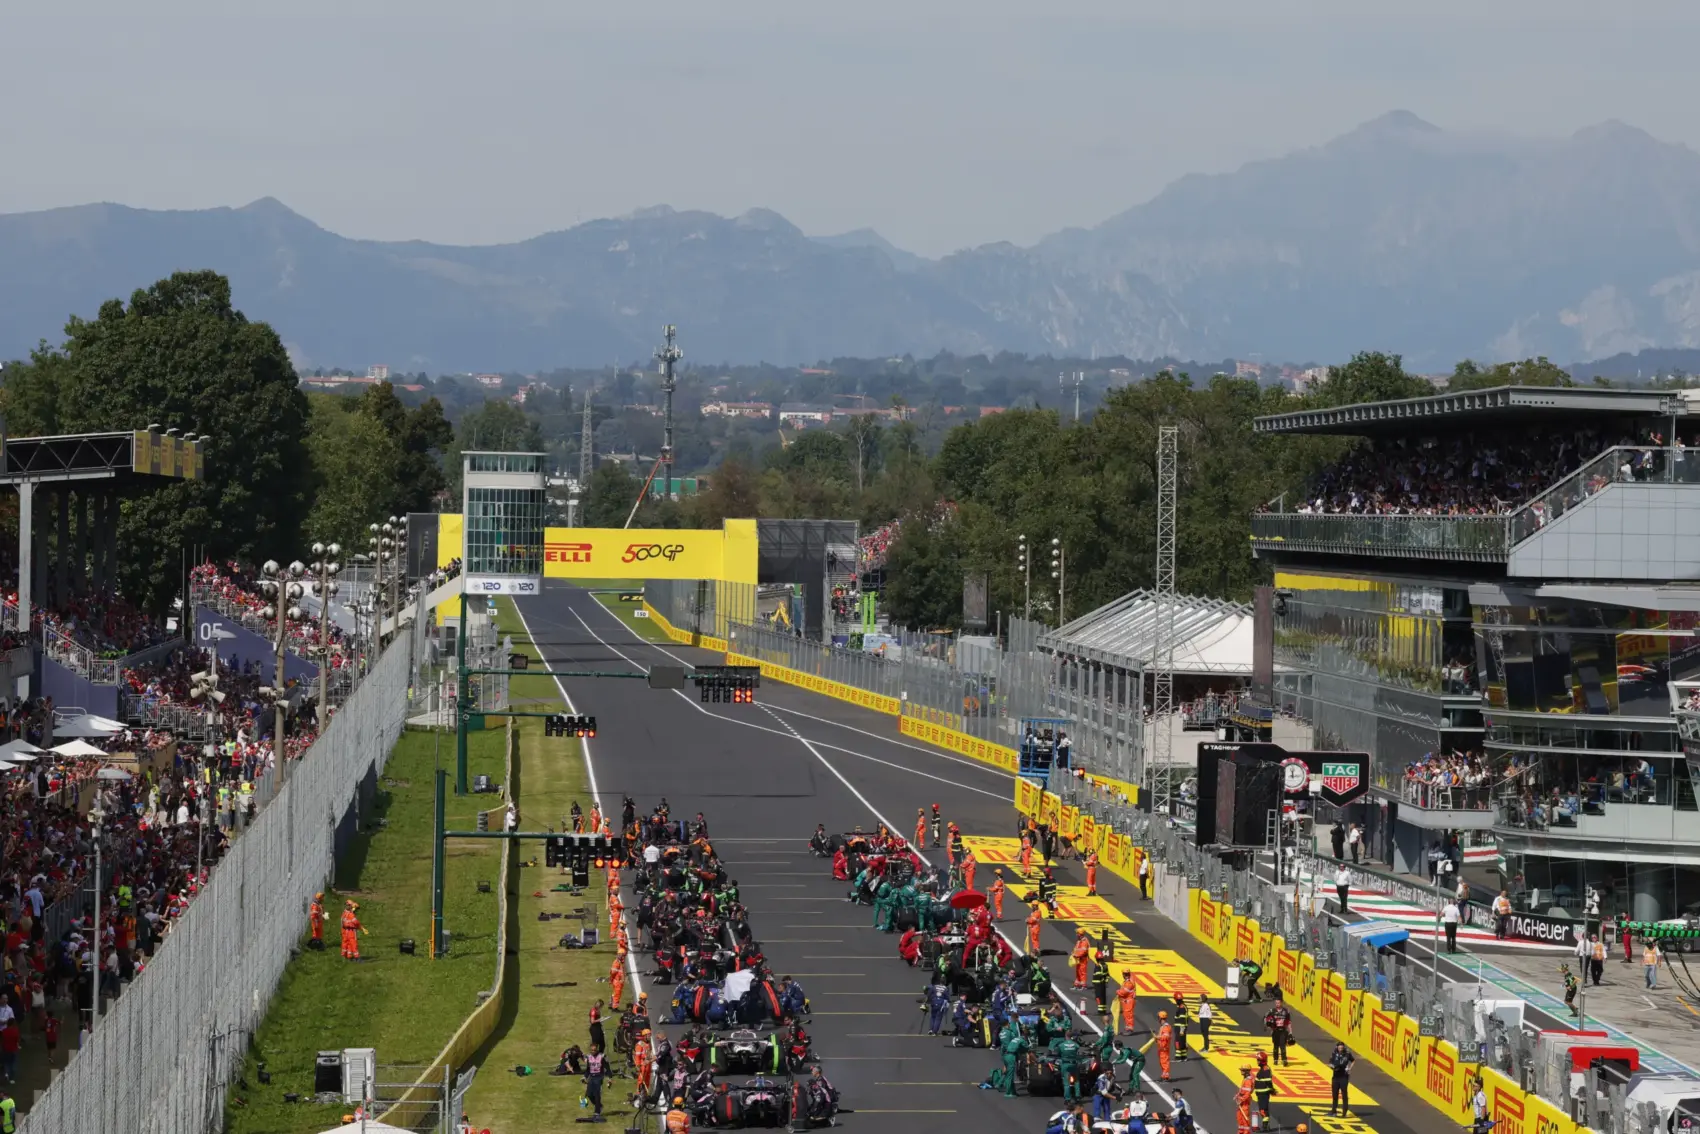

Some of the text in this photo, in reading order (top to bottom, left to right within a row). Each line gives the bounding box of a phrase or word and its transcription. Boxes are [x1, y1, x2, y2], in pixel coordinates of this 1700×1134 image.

[482, 582, 501, 591] 120
[518, 582, 534, 591] 120
[1325, 765, 1357, 776] TAG
[1323, 777, 1358, 793] HEUER
[1510, 915, 1569, 941] TAGHeuer
[1287, 933, 1298, 941] 55
[1316, 952, 1328, 960] 23
[1278, 948, 1296, 996] PIRELLI
[1348, 971, 1360, 980] 31
[1384, 992, 1396, 1001] 18
[1320, 976, 1342, 1029] PIRELLI
[1421, 1016, 1435, 1026] 43
[1371, 1008, 1395, 1064] PIRELLI
[1461, 1042, 1477, 1052] 30
[1426, 1044, 1454, 1105] PIRELLI
